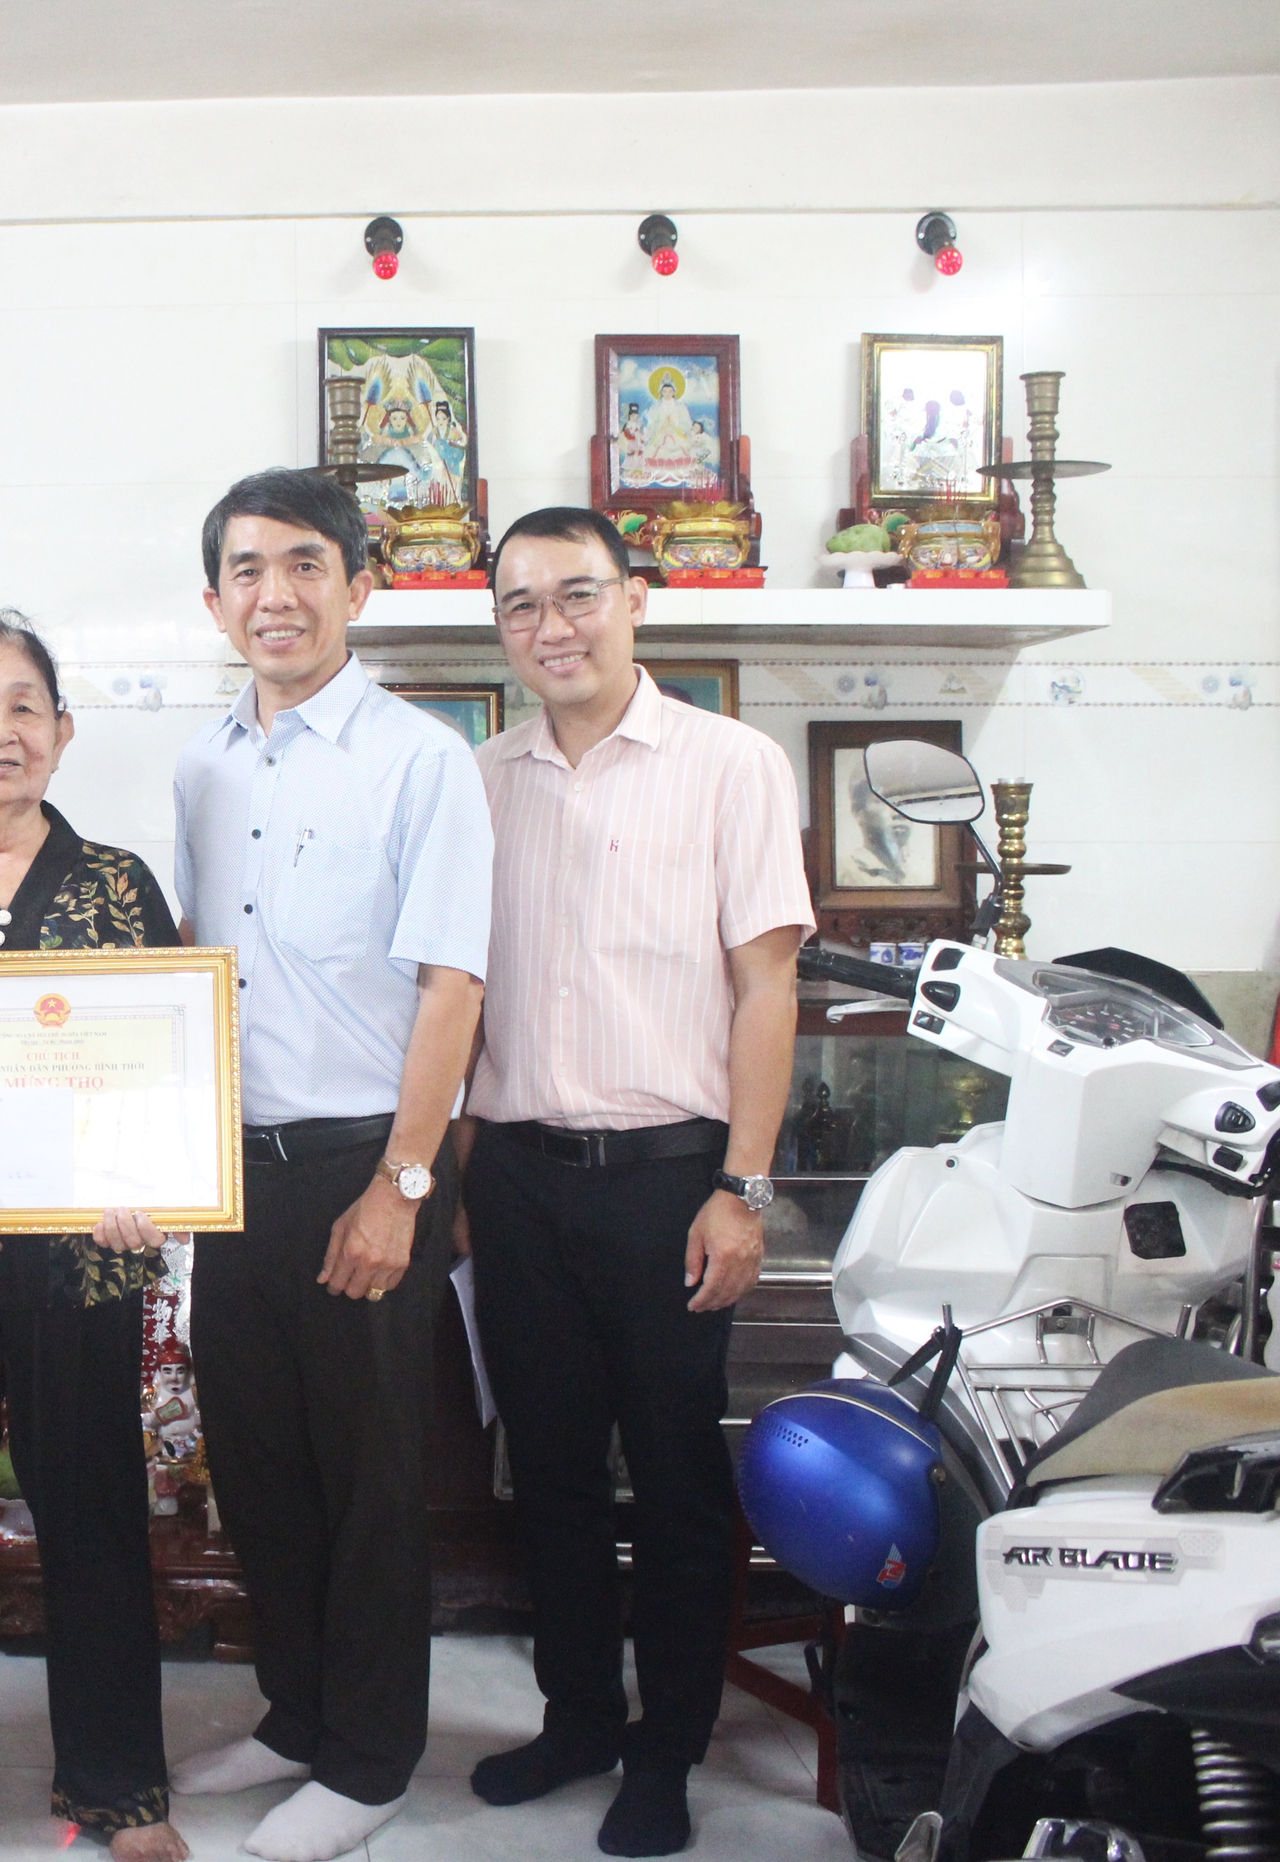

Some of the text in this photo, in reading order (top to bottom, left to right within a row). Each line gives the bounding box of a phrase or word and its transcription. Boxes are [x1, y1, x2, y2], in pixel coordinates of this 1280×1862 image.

[27, 1050, 80, 1062] CHỦ TỊCH
[0, 1064, 25, 1072] NHÂN
[29, 1063, 49, 1072] DÂN
[52, 1062, 91, 1072] PHƯỜNG
[94, 1061, 118, 1071] BÌNH
[121, 1060, 145, 1070] THỚI
[4, 1074, 104, 1091] MỪNG THỌ
[1002, 1546, 1179, 1574] AIR BLADE
